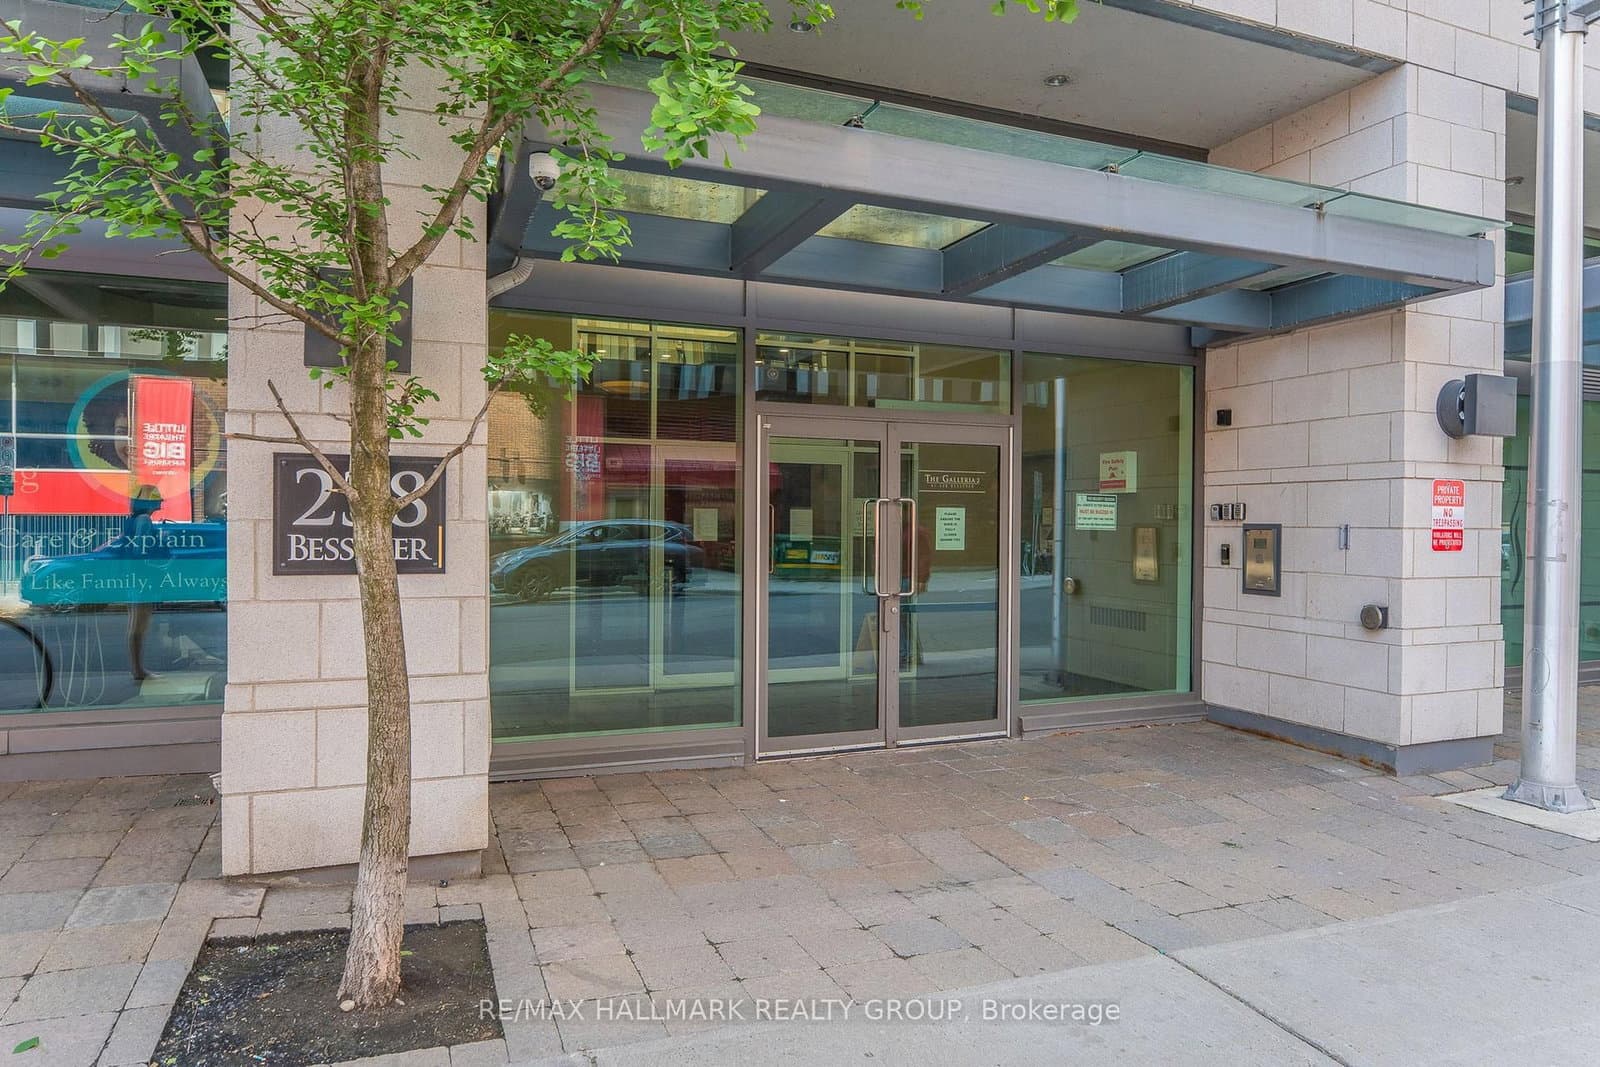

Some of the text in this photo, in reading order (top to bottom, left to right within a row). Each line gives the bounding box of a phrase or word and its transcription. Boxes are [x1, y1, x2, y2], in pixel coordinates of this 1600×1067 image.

[292, 468, 428, 527] 28
[1437, 485, 1460, 495] PRIVATE
[1434, 495, 1463, 505] PROPERTY
[1443, 508, 1454, 517] NO
[1432, 518, 1463, 528] TRESPASSING
[0, 527, 206, 555] Care & Explain
[287, 533, 432, 561] BESSER
[31, 572, 227, 593] Like Family, Always
